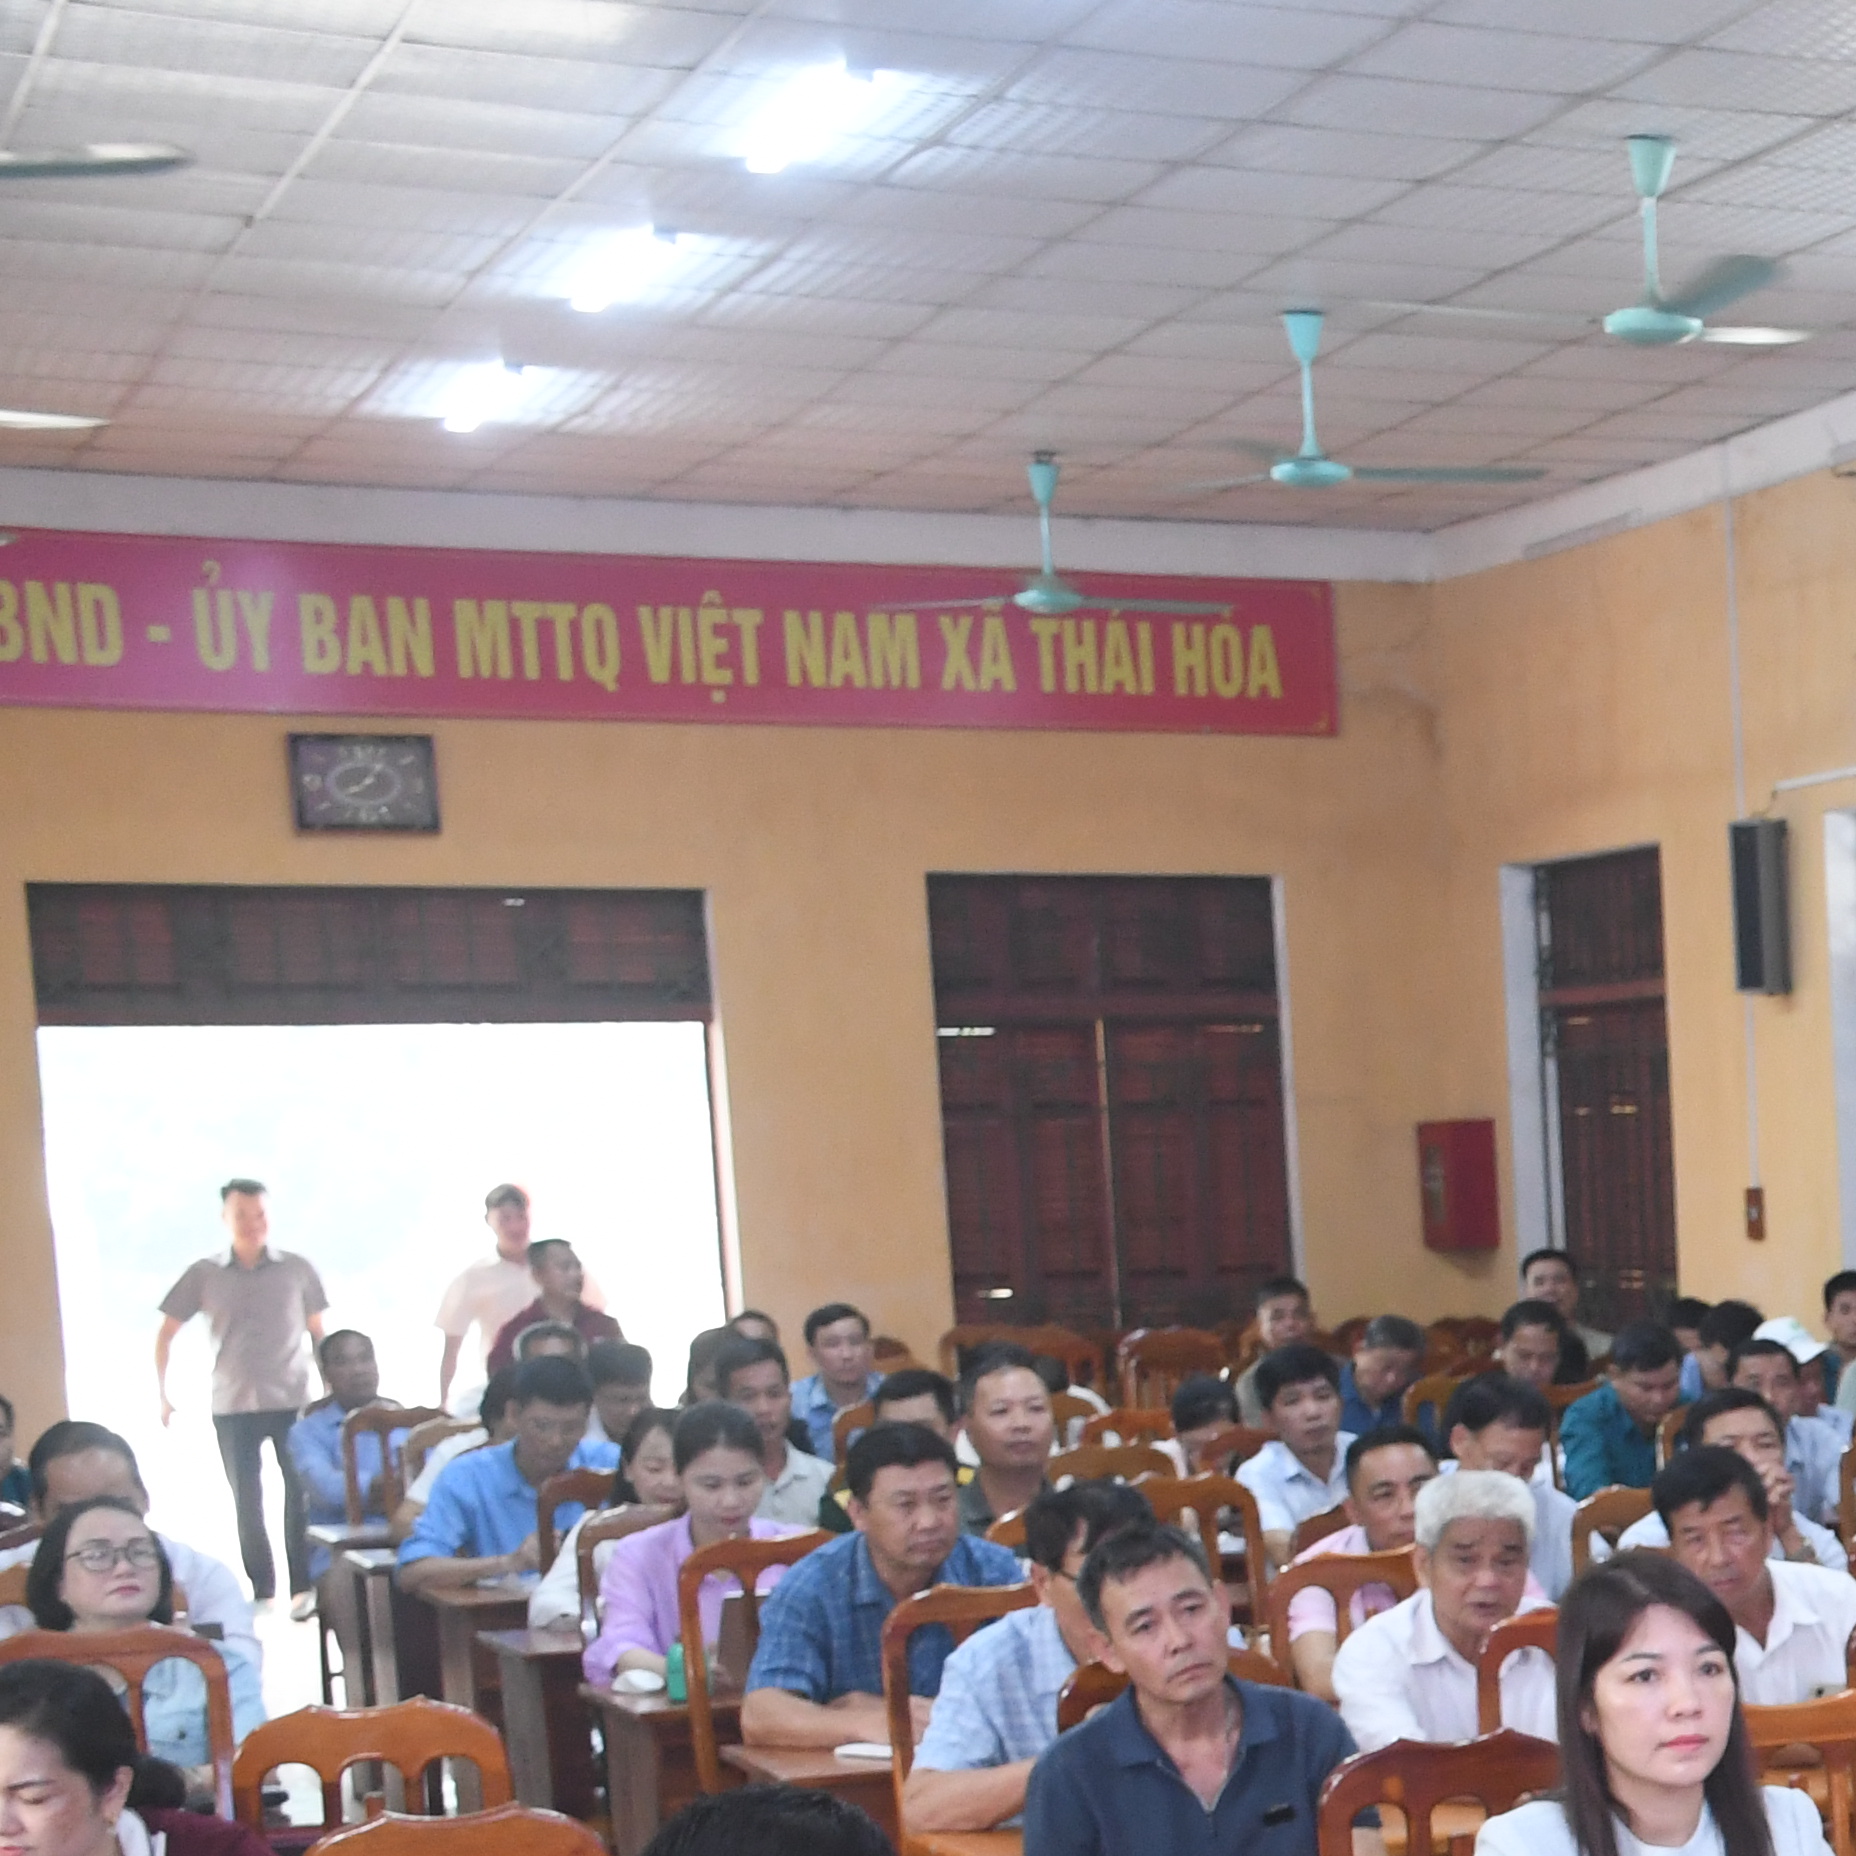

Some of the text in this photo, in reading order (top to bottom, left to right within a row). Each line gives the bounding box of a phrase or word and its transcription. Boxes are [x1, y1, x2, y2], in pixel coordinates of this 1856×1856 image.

[192, 560, 275, 672] ỦY
[297, 593, 436, 678] BAN
[453, 598, 622, 692] MTTQ
[638, 589, 765, 703] VIỆT
[783, 609, 922, 691] NAM
[1028, 608, 1157, 697] THÁI
[1170, 608, 1284, 700] HÒA
